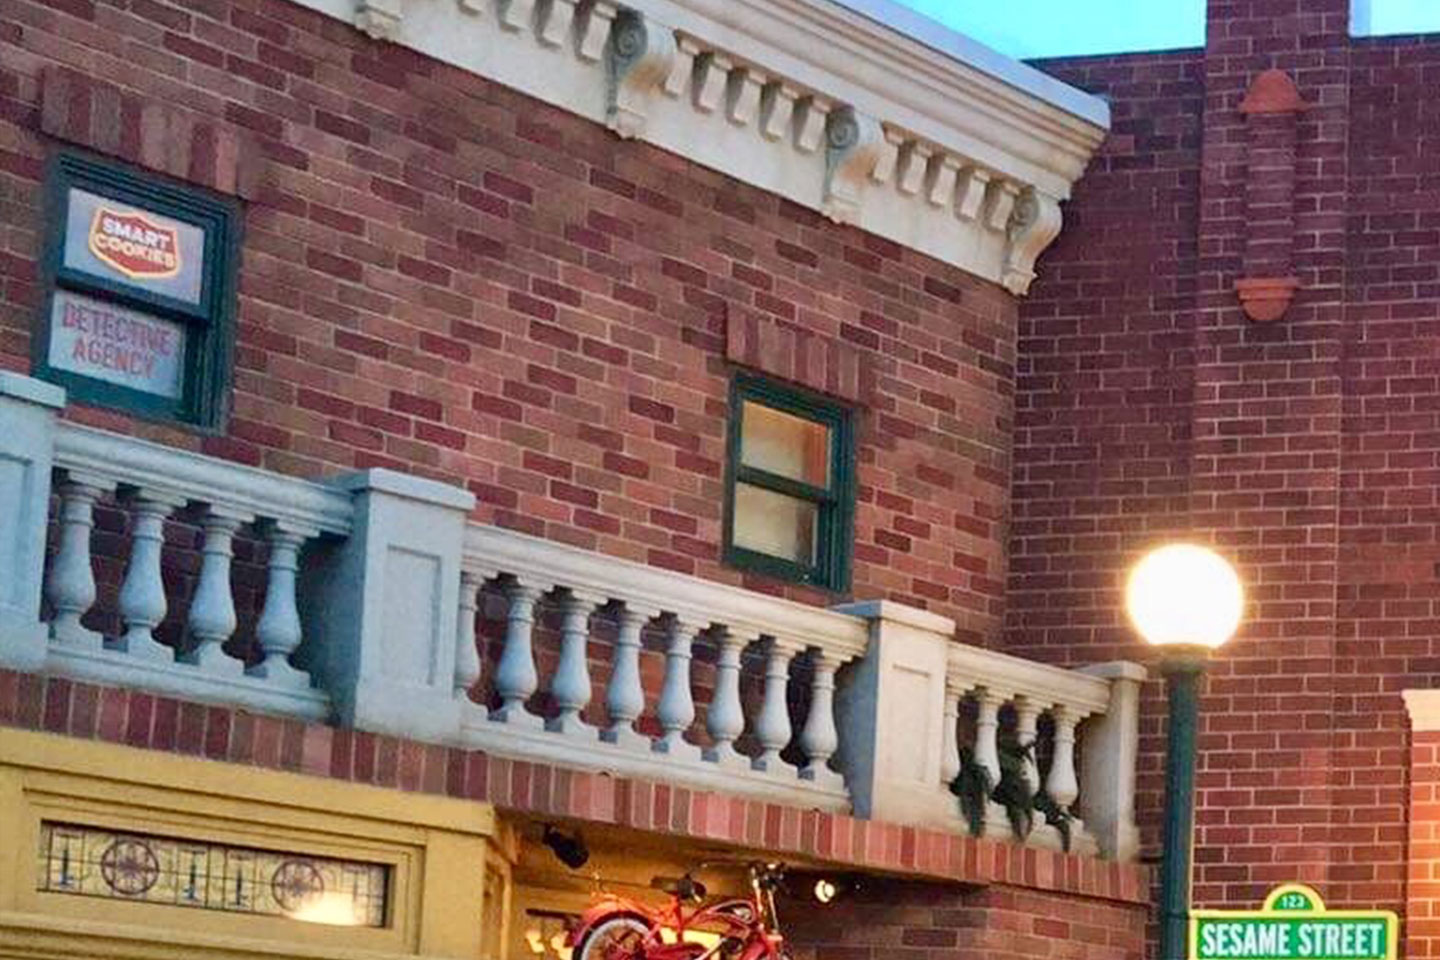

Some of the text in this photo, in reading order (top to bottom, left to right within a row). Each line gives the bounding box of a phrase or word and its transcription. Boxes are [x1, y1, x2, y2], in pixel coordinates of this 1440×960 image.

[94, 233, 176, 268] COOKIES
[102, 217, 171, 250] SMART
[63, 301, 171, 356] DETECTIVE
[72, 336, 156, 379] AGENCY
[1281, 894, 1305, 909] 123
[1202, 923, 1383, 956] SESAME STREET
